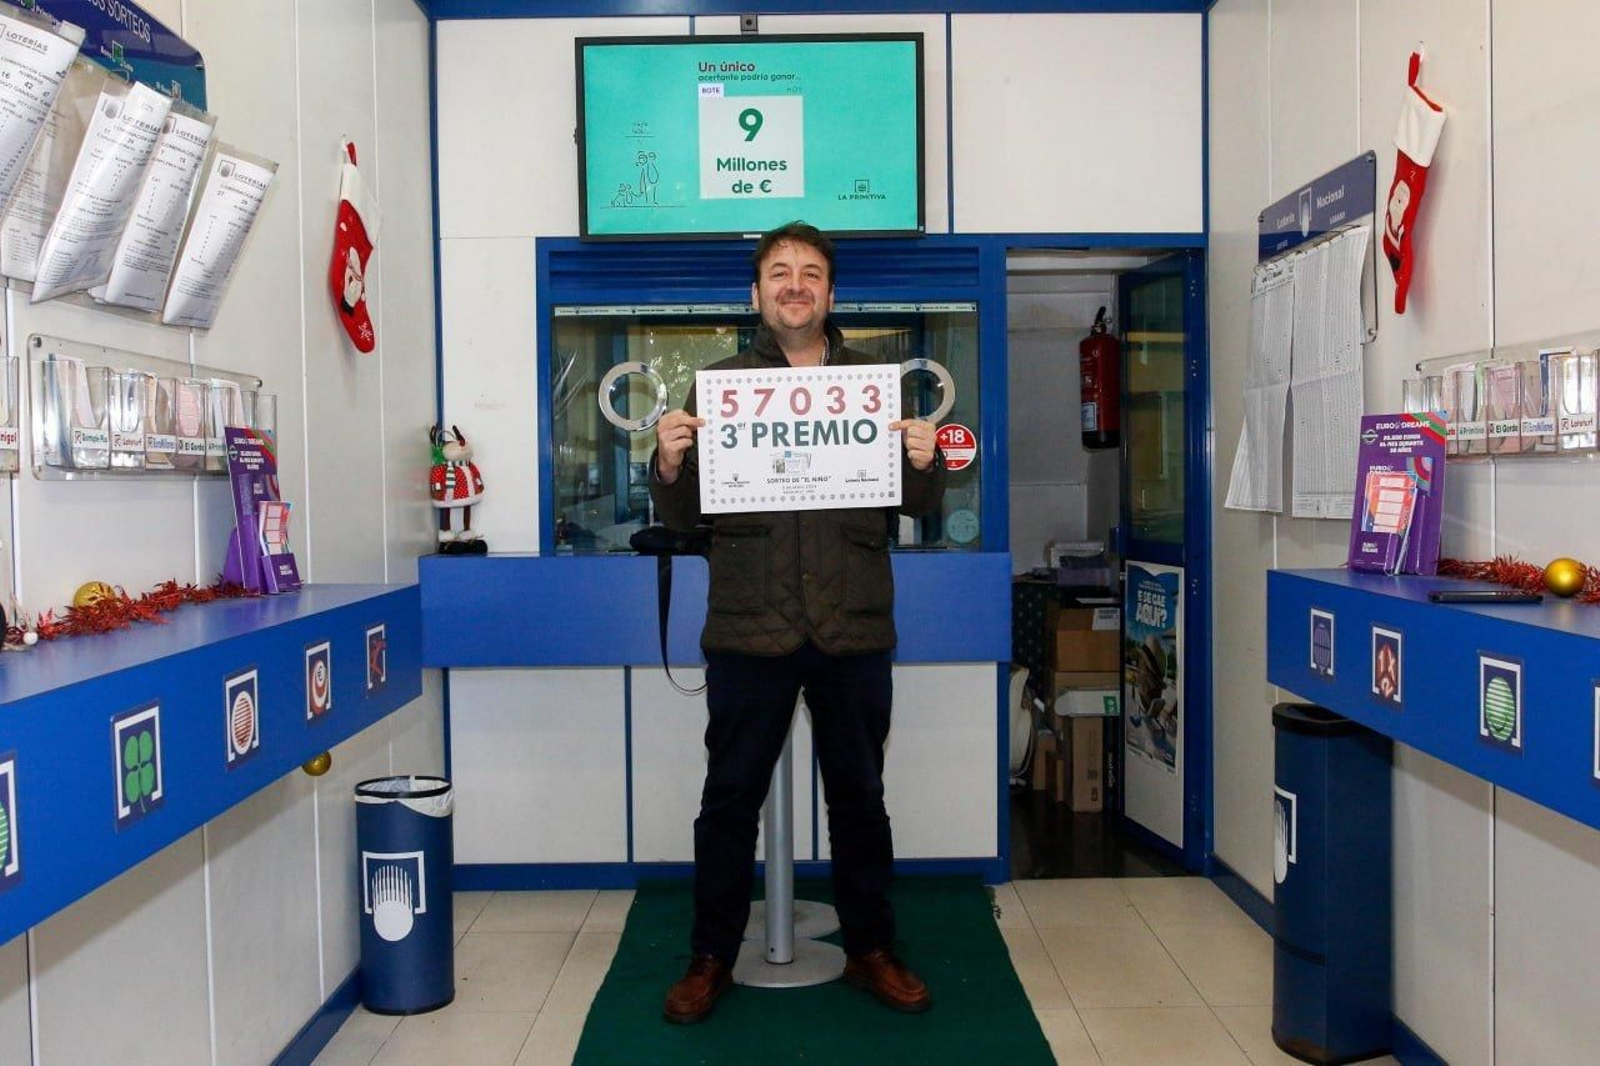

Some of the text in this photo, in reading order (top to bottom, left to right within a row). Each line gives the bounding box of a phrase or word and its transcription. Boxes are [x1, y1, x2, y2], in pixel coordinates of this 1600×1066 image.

[108, 0, 150, 43] SORTEOS
[698, 60, 756, 73] Un único
[698, 73, 740, 82] acertante
[740, 72, 769, 82] podría
[701, 86, 721, 94] BOTE
[738, 107, 764, 142] 9
[716, 156, 788, 173] Millones
[732, 179, 772, 194] de €
[1316, 184, 1345, 210] Nacional
[1375, 420, 1431, 430] EURO DREAMS
[1496, 423, 1519, 433] El Gordo
[1570, 418, 1593, 428] Lototurf
[751, 418, 878, 448] PREMIO
[940, 428, 966, 445] +18
